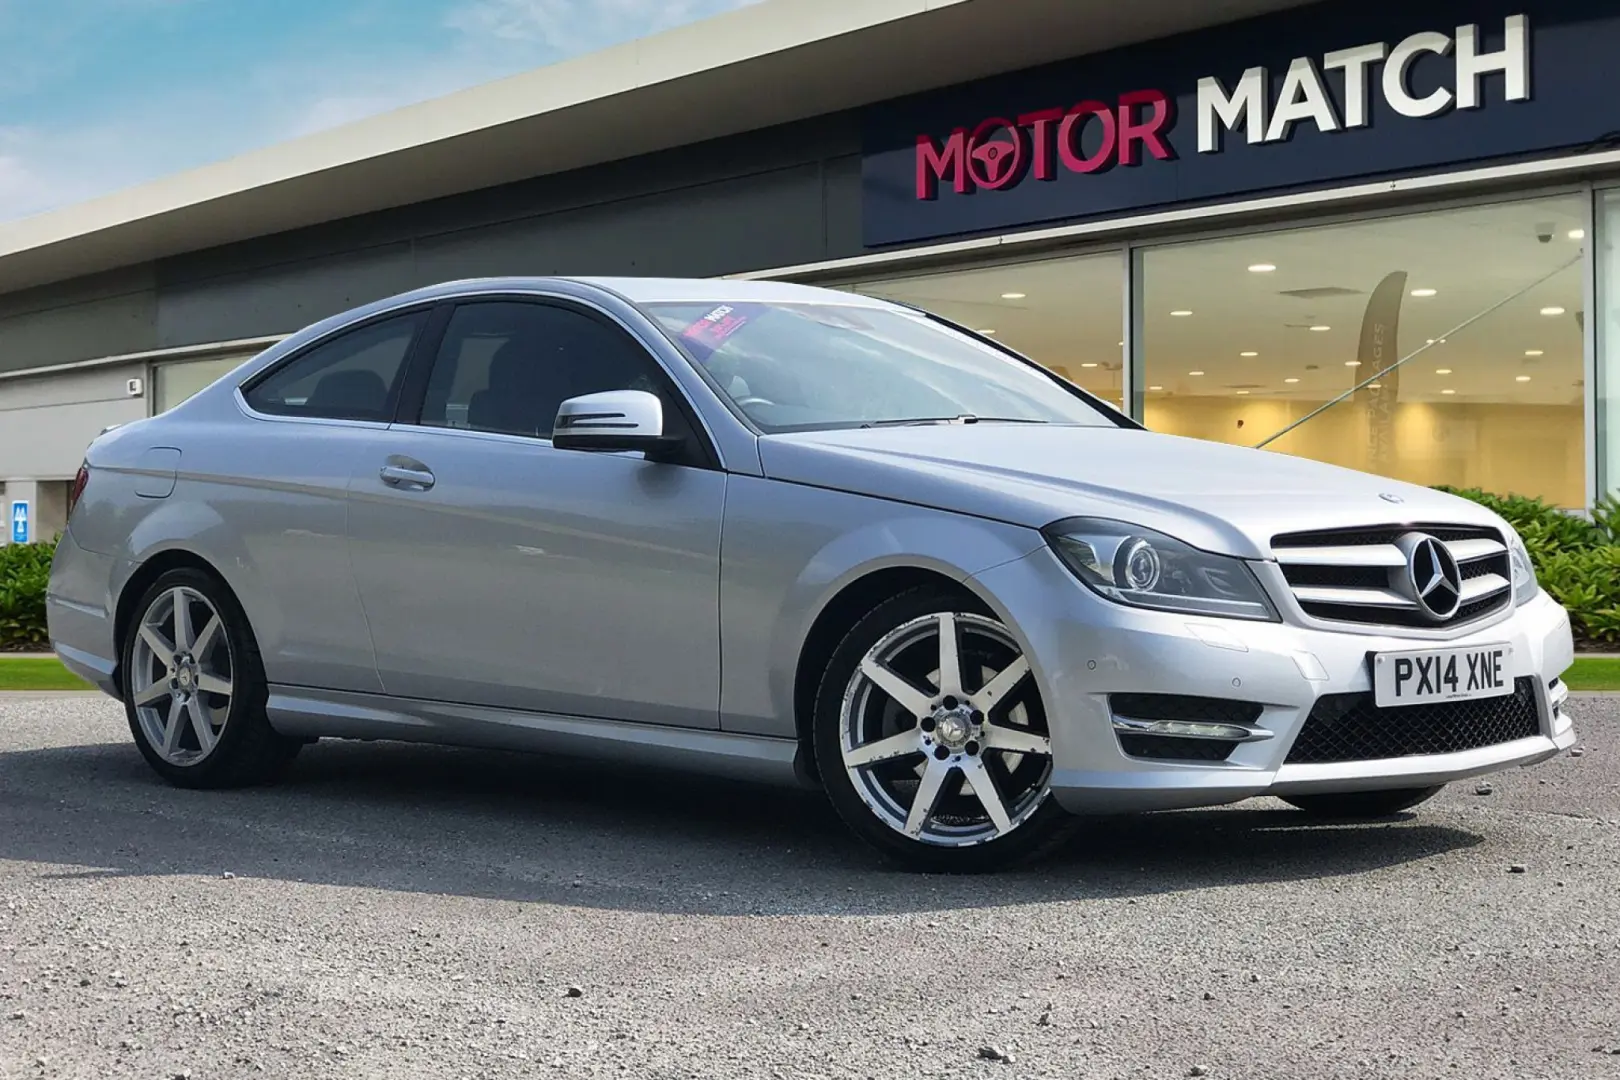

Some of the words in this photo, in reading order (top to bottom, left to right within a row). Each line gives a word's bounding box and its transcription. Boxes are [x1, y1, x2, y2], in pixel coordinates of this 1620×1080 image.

[916, 89, 1175, 200] MOTOR
[1197, 14, 1529, 153] MATCH
[1395, 655, 1459, 696] PX14
[1467, 651, 1503, 691] XNE
